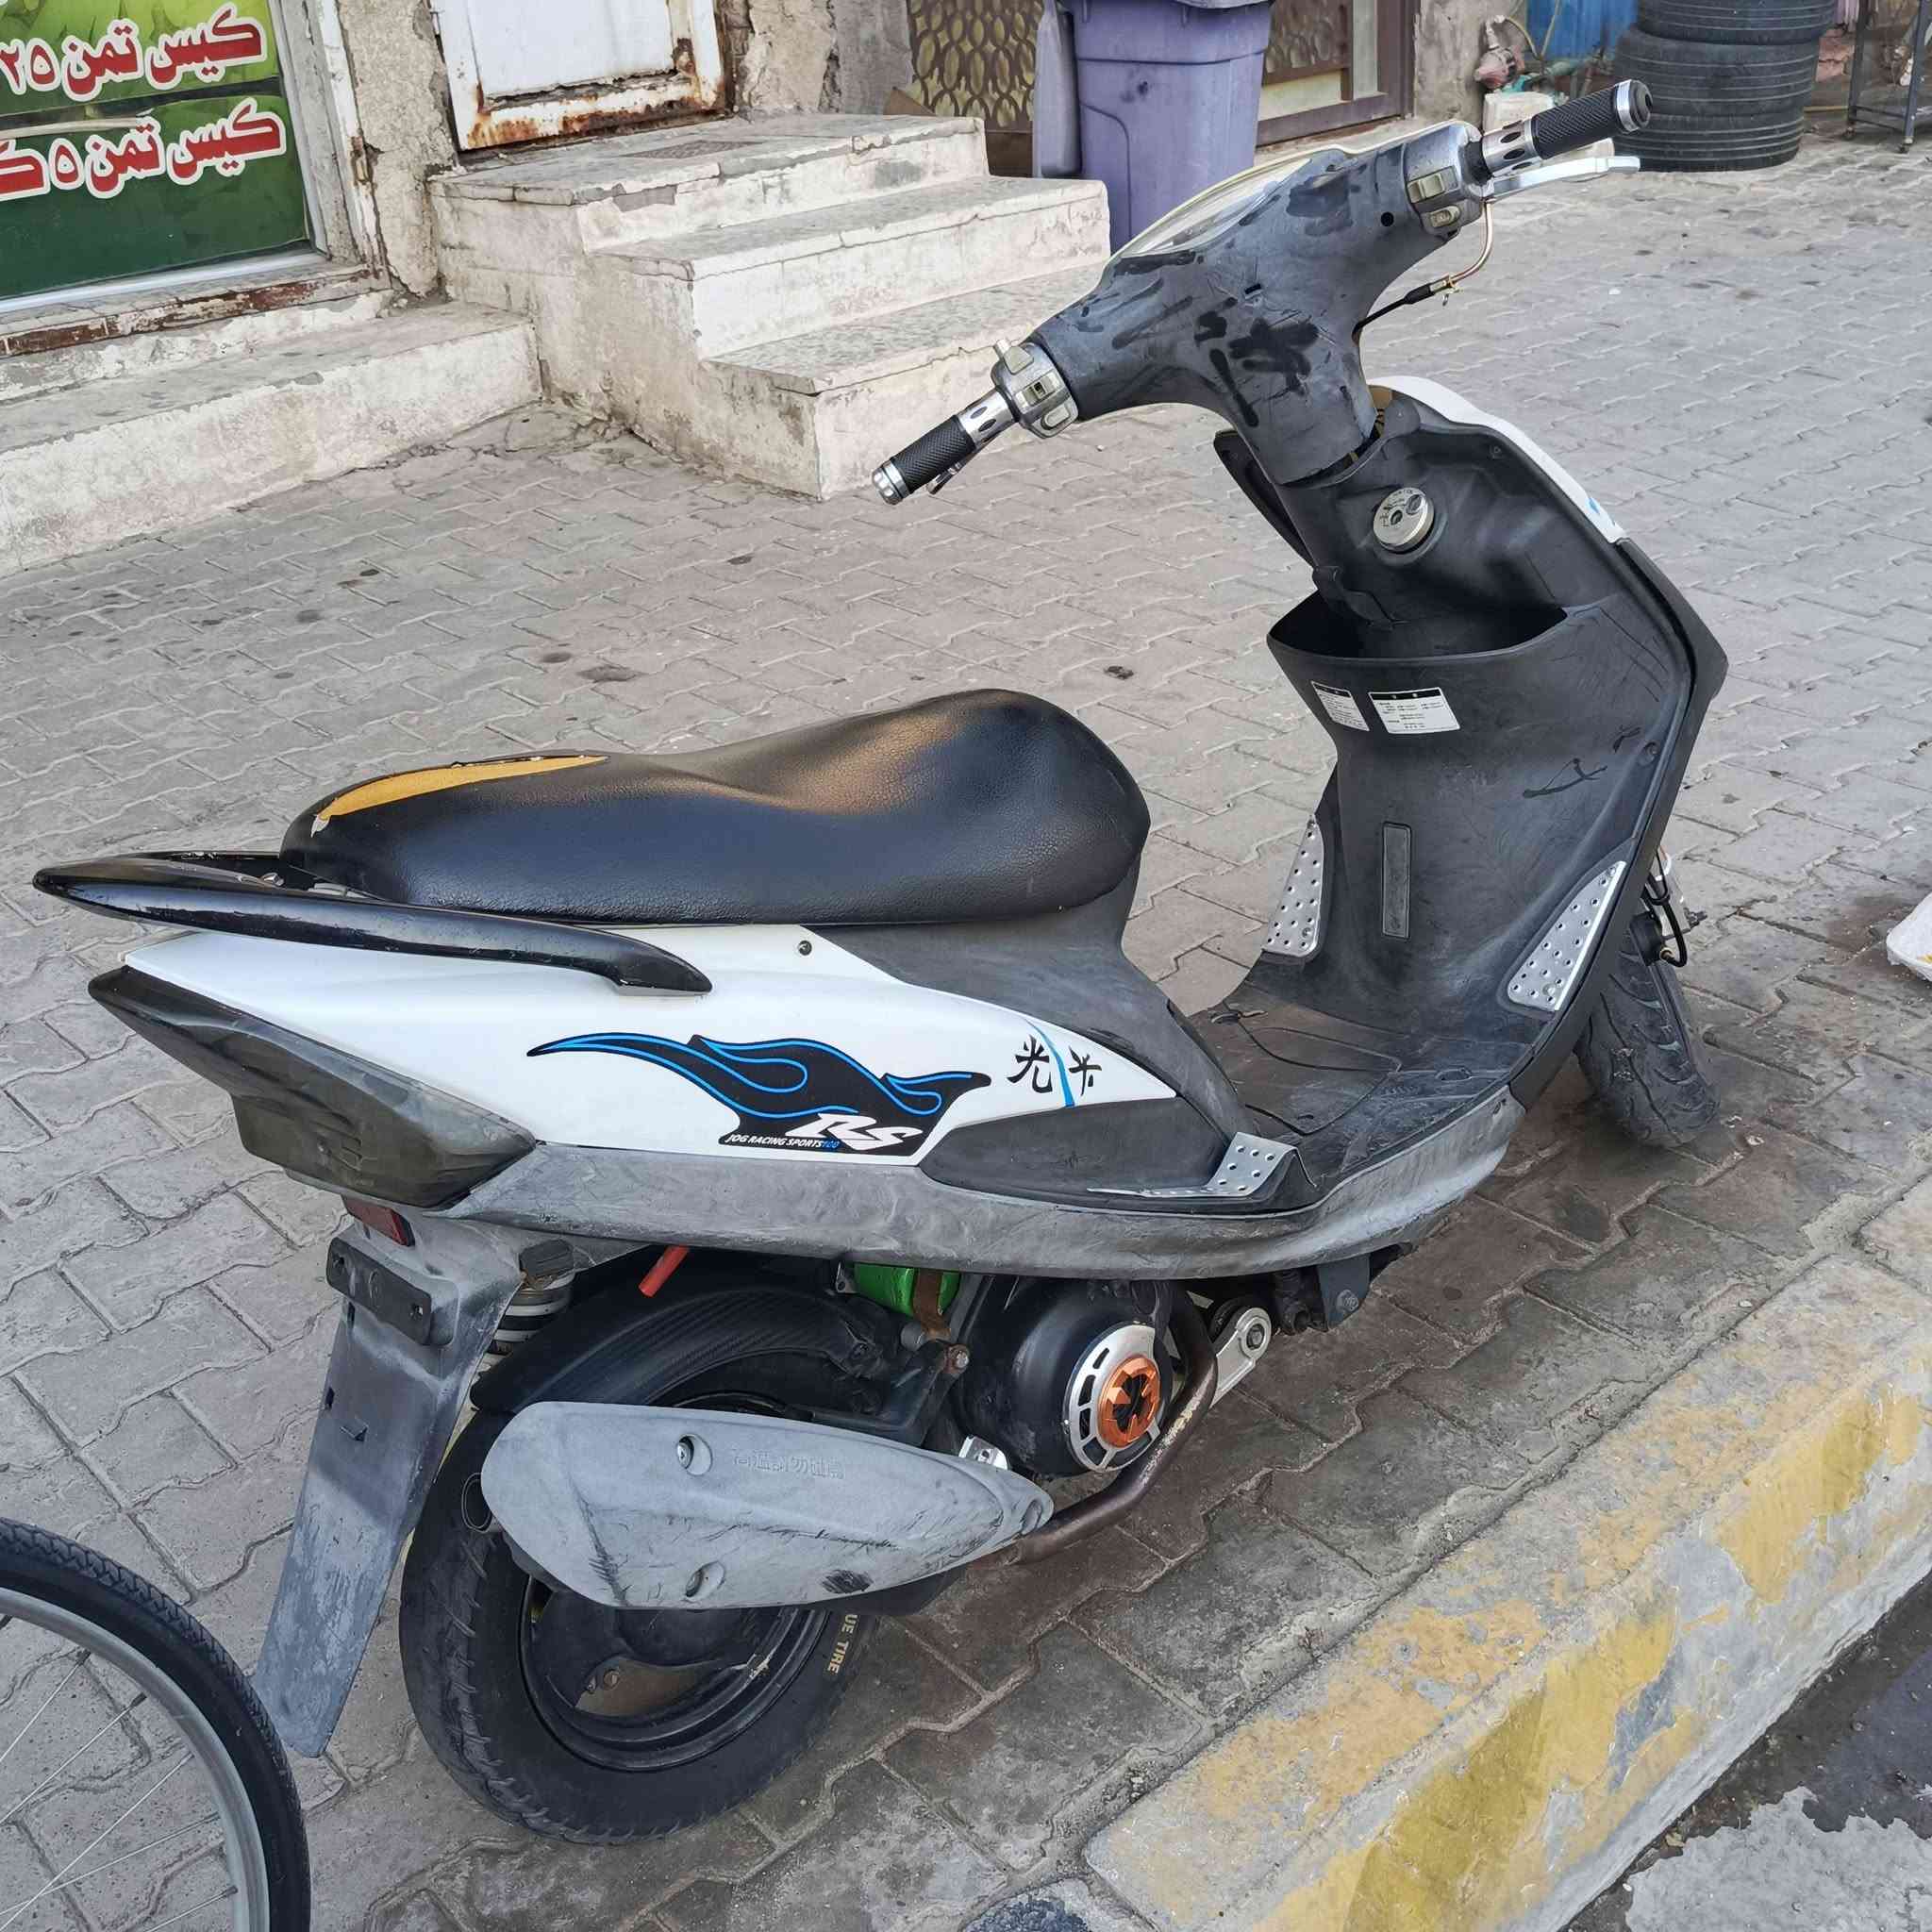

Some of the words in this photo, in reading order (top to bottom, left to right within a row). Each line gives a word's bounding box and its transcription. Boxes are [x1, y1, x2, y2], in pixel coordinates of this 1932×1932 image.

[147, 5, 264, 87] كيس
[169, 101, 284, 181] كيس
[724, 1133, 748, 1143] JOG
[748, 1135, 786, 1146] RACING
[826, 1641, 849, 1674] TIRE
